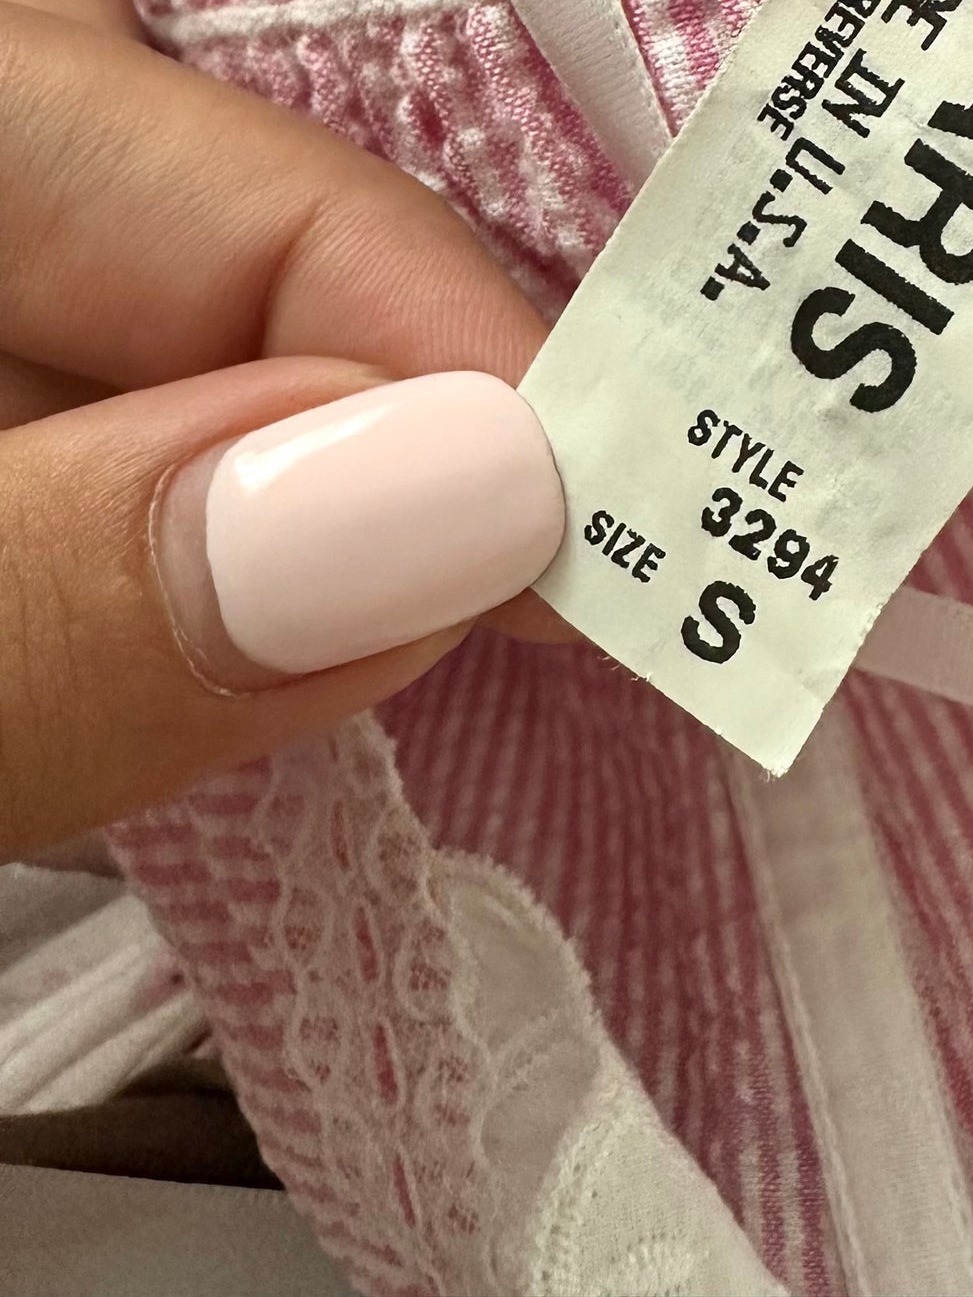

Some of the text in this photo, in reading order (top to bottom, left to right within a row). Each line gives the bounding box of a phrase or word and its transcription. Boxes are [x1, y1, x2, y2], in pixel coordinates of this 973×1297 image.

[822, 48, 905, 138] IN
[700, 136, 846, 302] U.S.A.
[687, 409, 805, 503] STYLE
[583, 510, 757, 665] SIZE S
[701, 487, 840, 601] 3294
